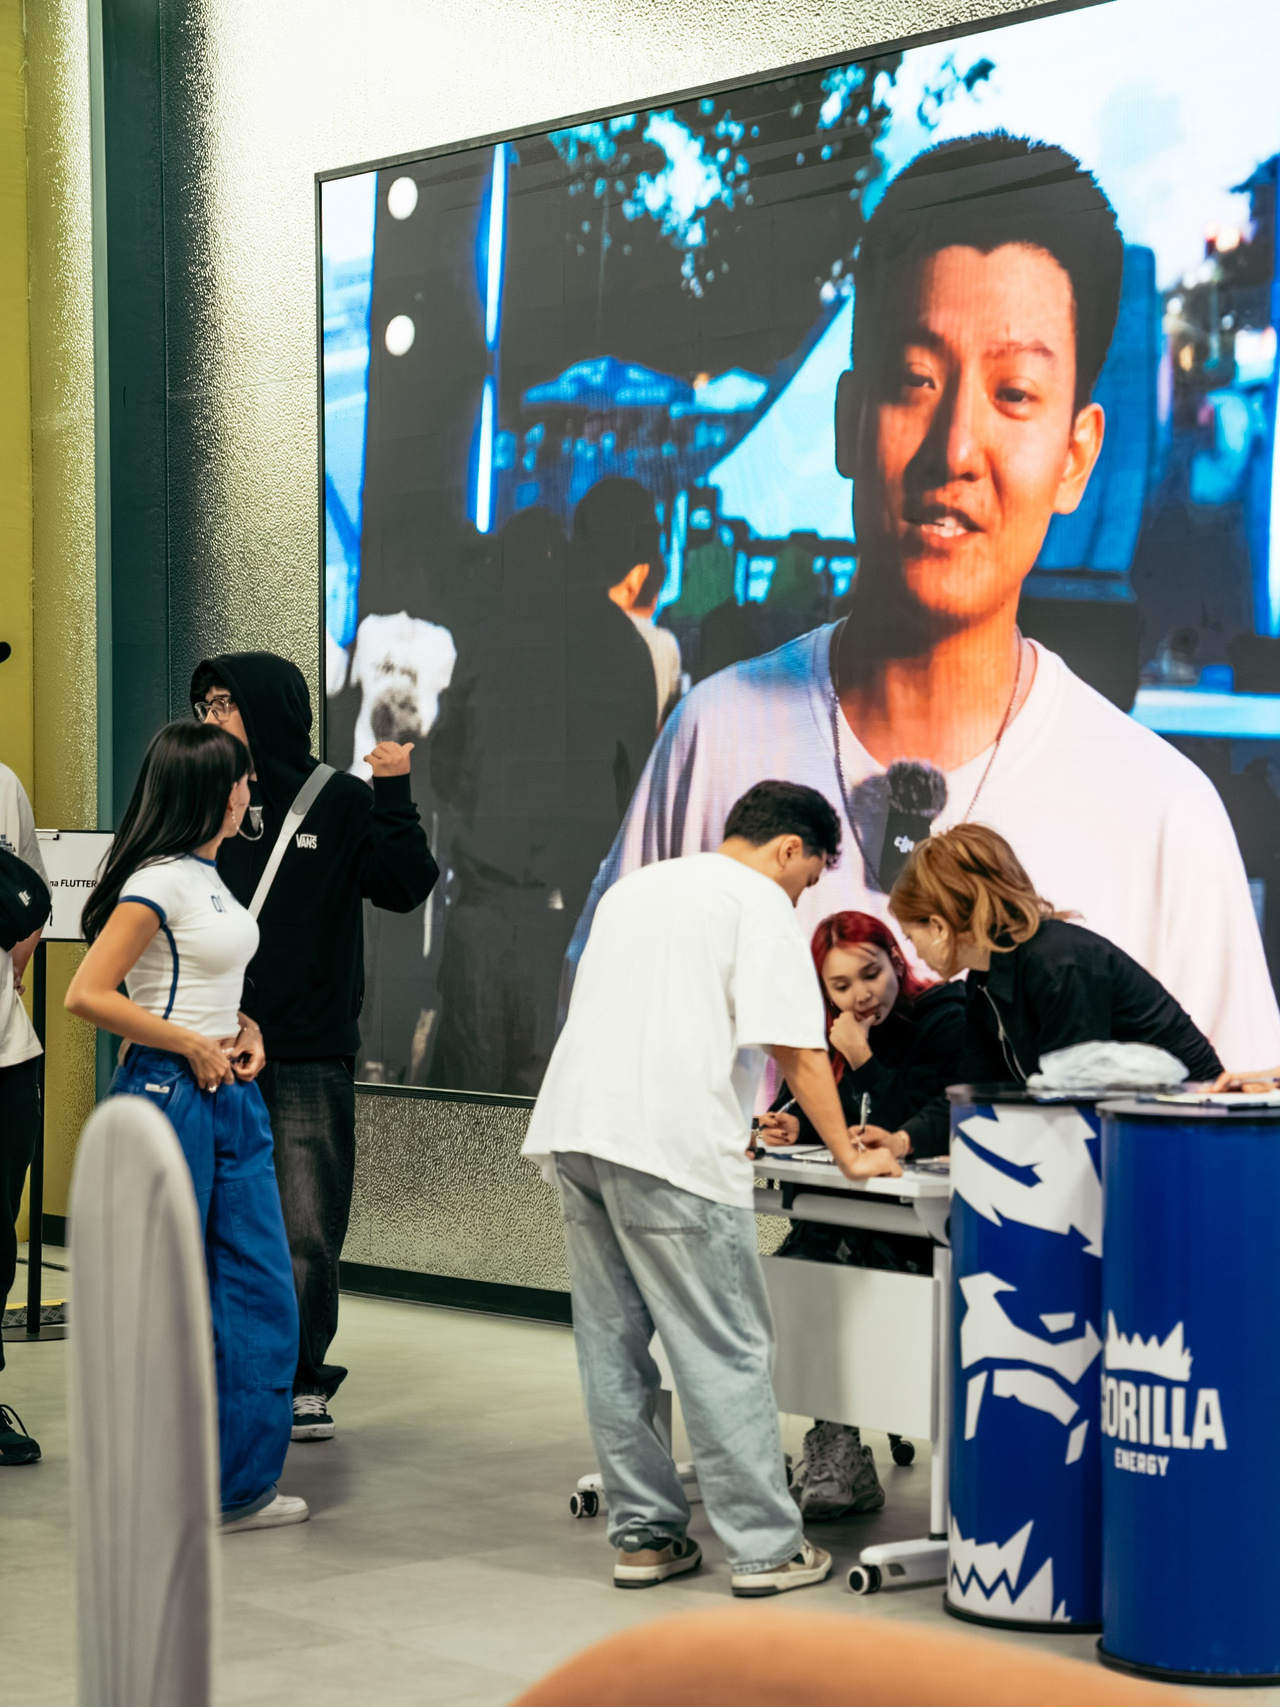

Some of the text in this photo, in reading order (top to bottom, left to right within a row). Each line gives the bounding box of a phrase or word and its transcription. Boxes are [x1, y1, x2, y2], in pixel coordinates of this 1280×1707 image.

[295, 833, 318, 850] VANS
[60, 879, 97, 888] FLUTTER
[1100, 1373, 1228, 1451] ORILLA
[1114, 1446, 1170, 1477] ENERGY
